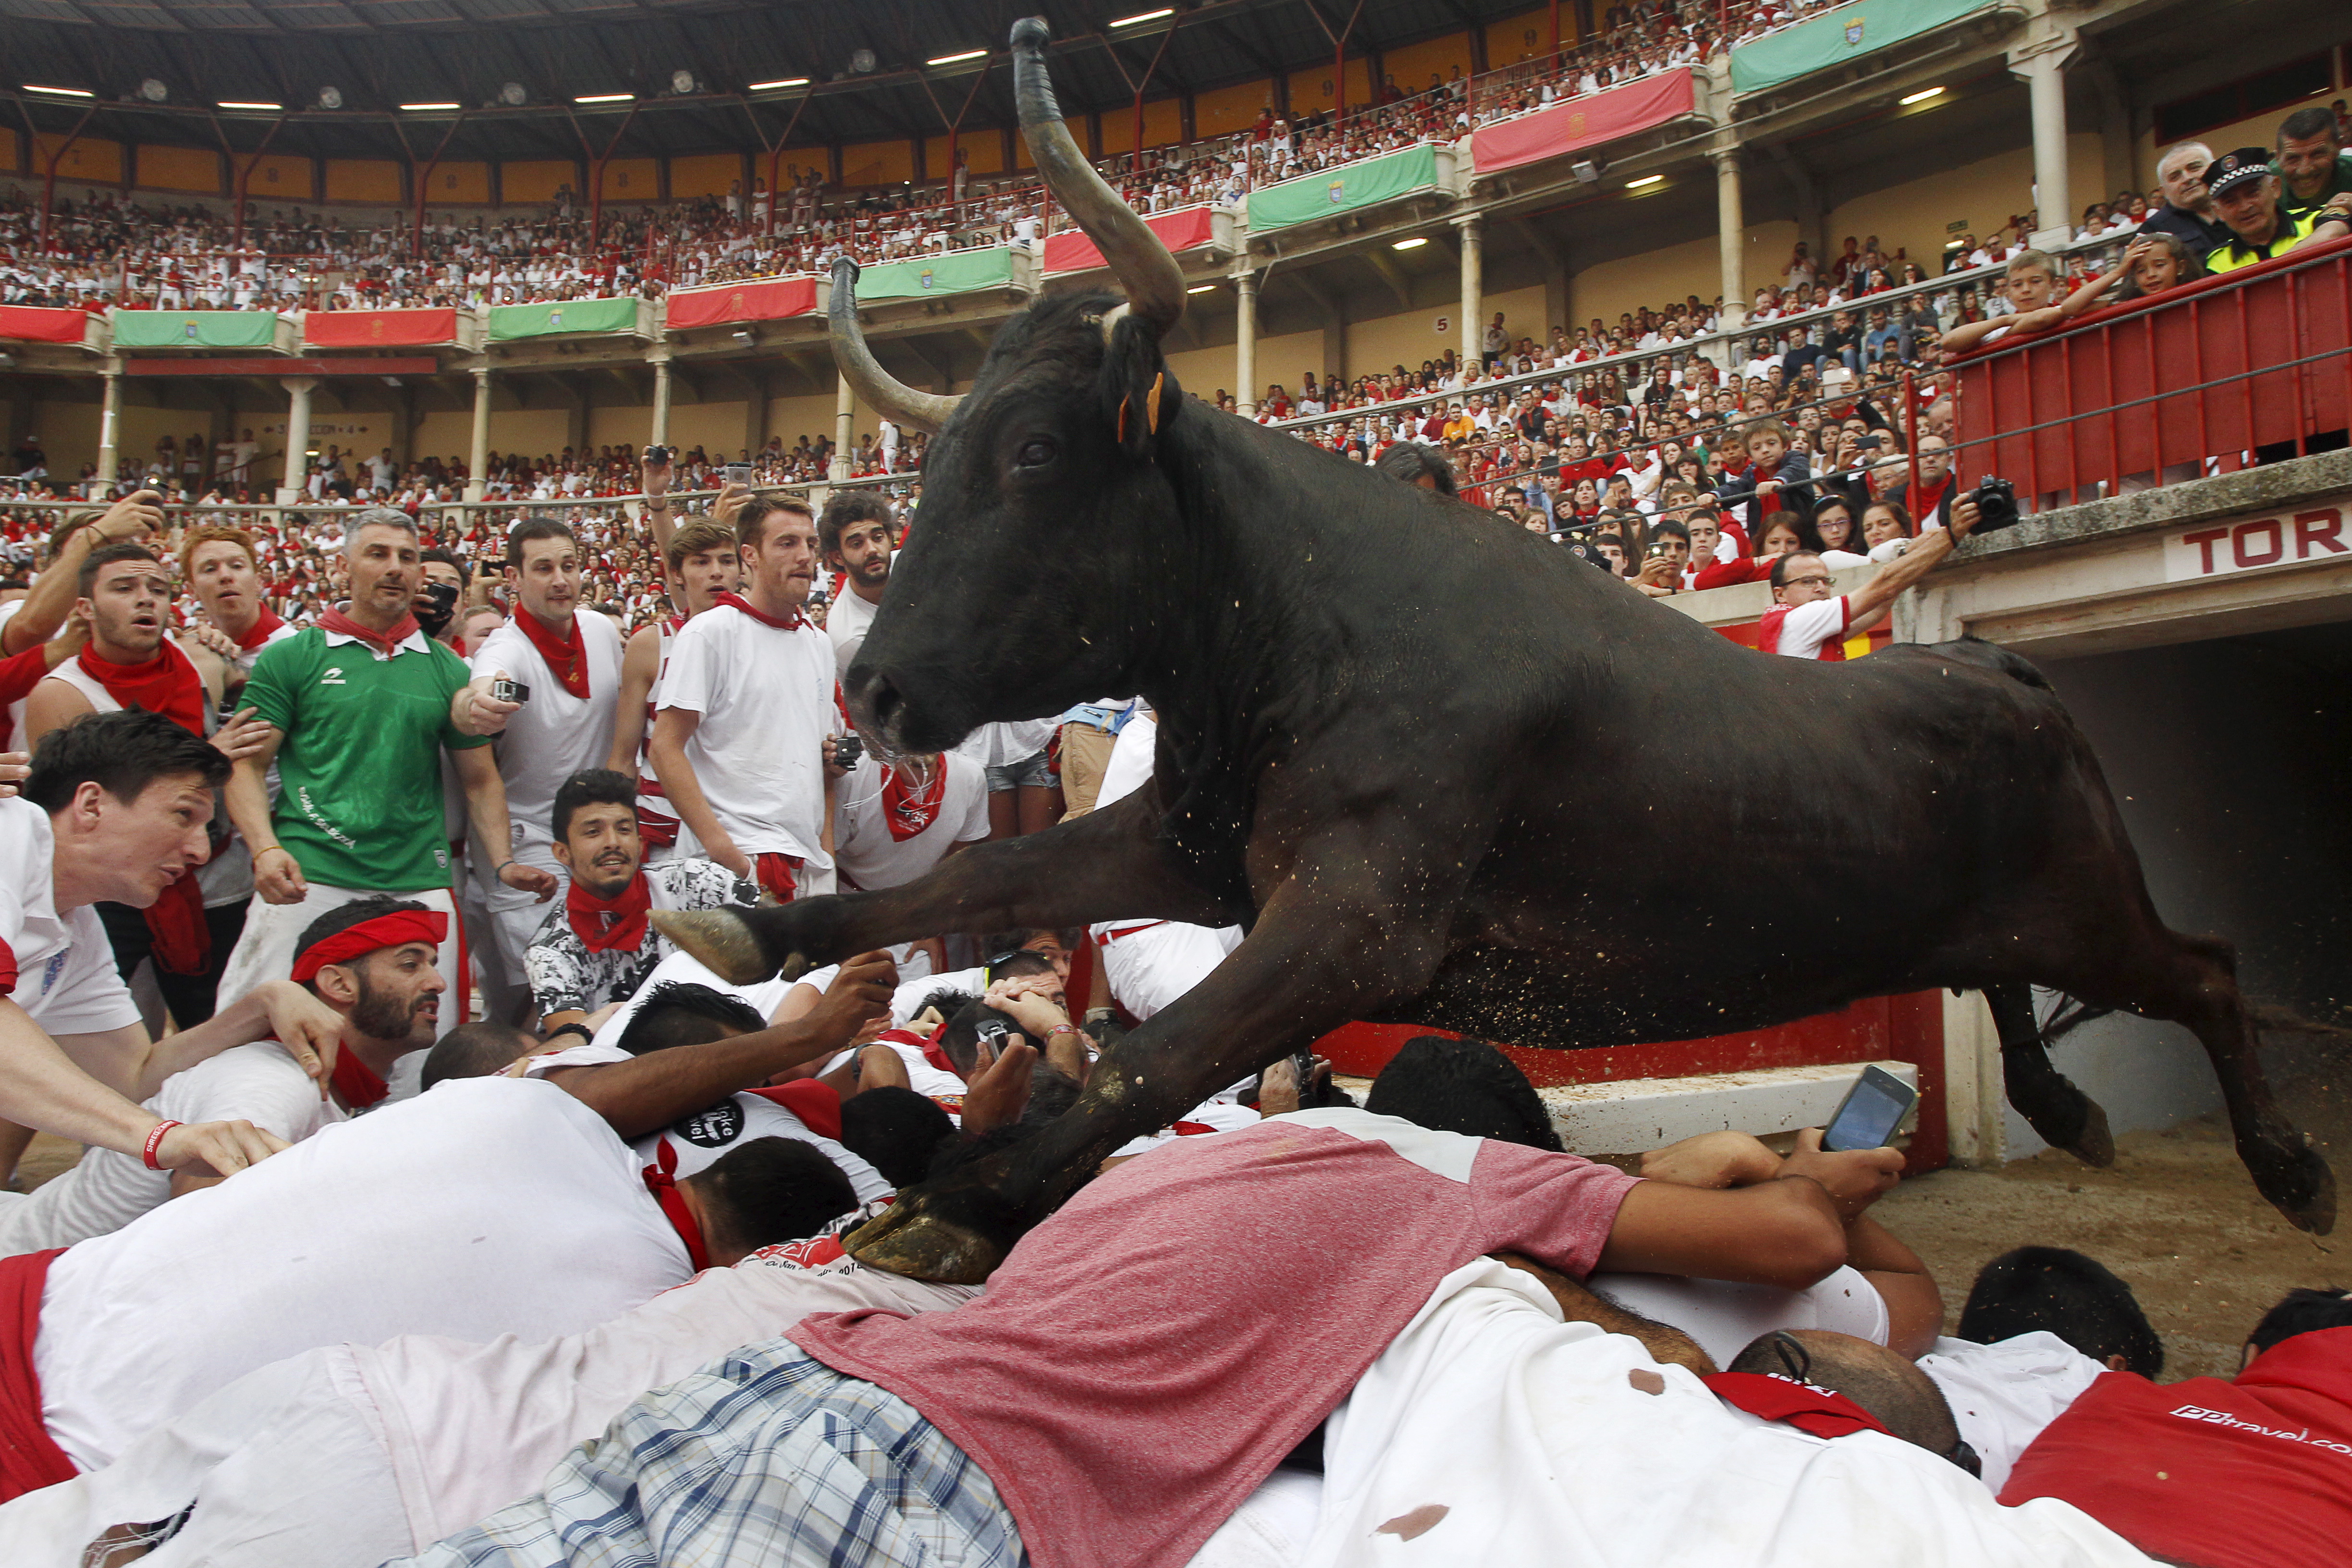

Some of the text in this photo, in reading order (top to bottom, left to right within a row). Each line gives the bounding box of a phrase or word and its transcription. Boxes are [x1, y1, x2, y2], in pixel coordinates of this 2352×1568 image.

[1322, 80, 1335, 97] 9
[1437, 318, 1447, 331] 5
[779, 1260, 796, 1271] San
[2168, 1403, 2352, 1458] PPtravel.co
